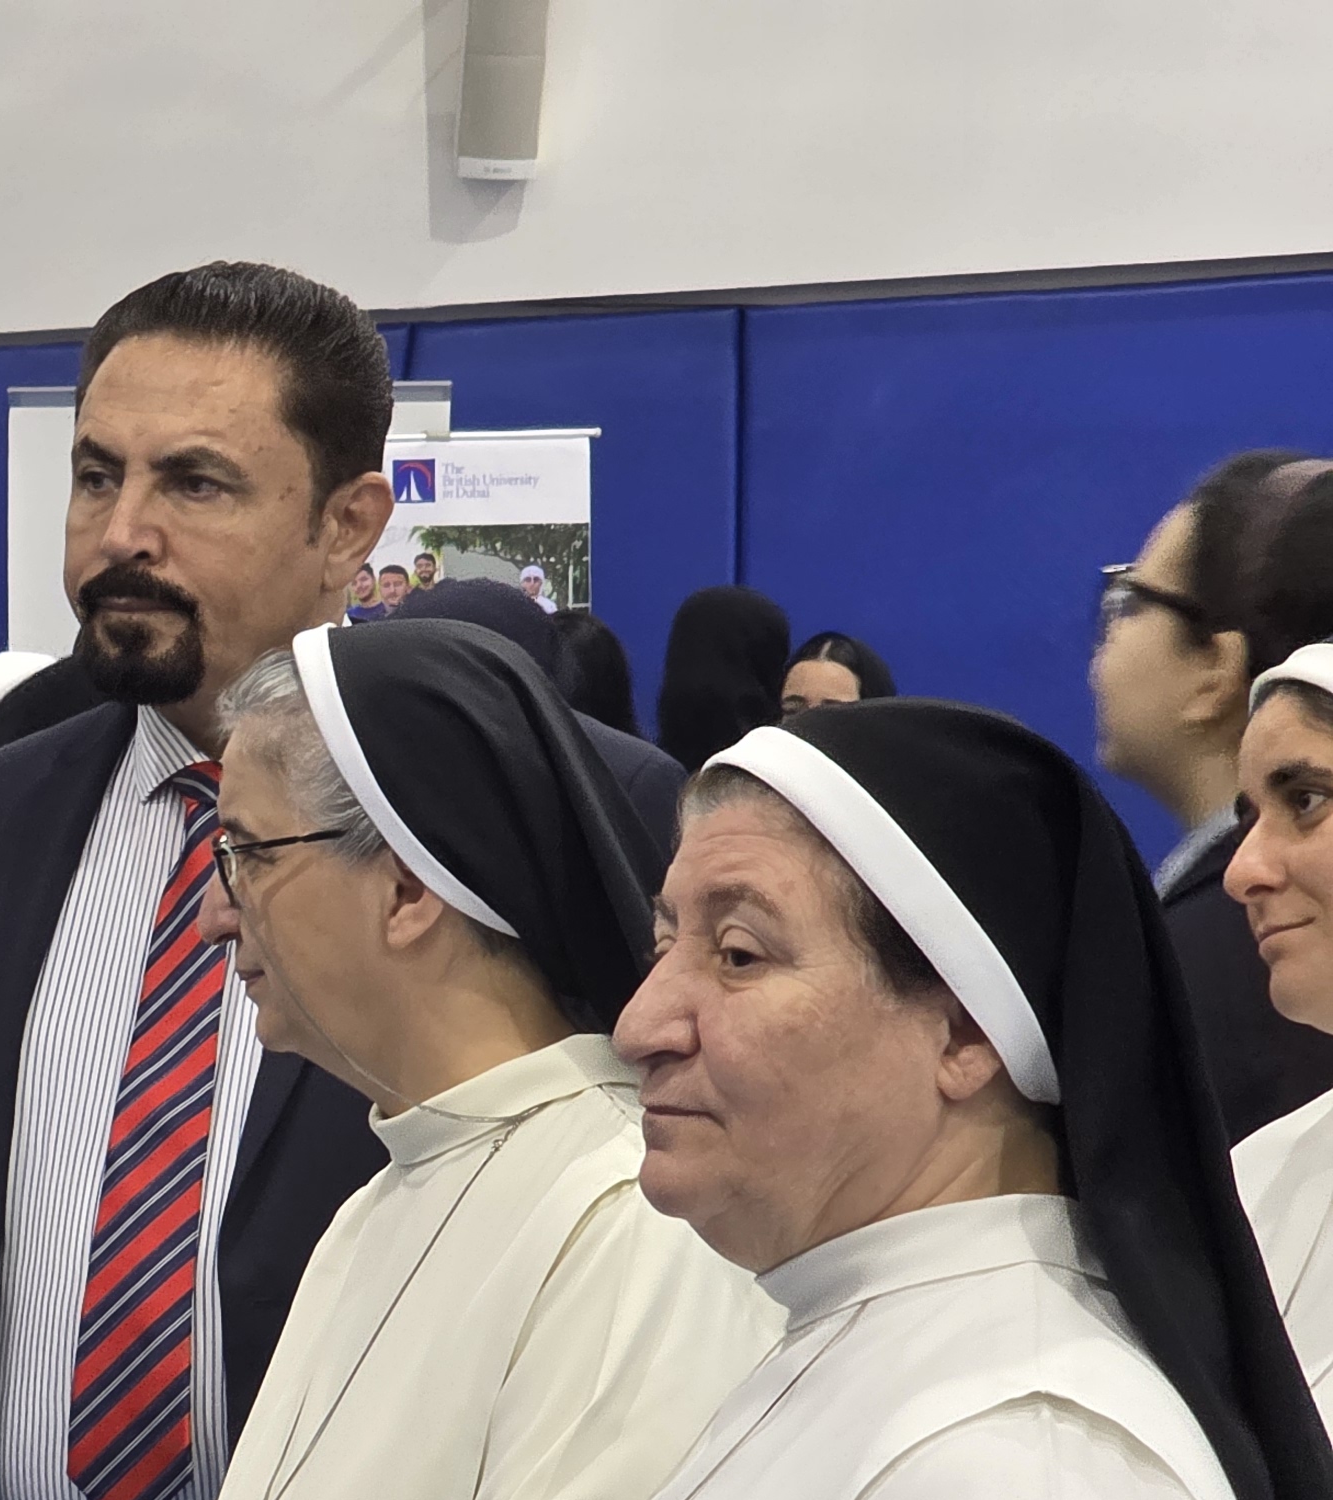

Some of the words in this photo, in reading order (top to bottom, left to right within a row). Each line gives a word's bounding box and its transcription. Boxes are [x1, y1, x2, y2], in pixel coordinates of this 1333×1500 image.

[441, 462, 465, 475] The
[442, 474, 480, 487] British
[482, 473, 540, 489] University
[455, 487, 490, 499] Dubai
